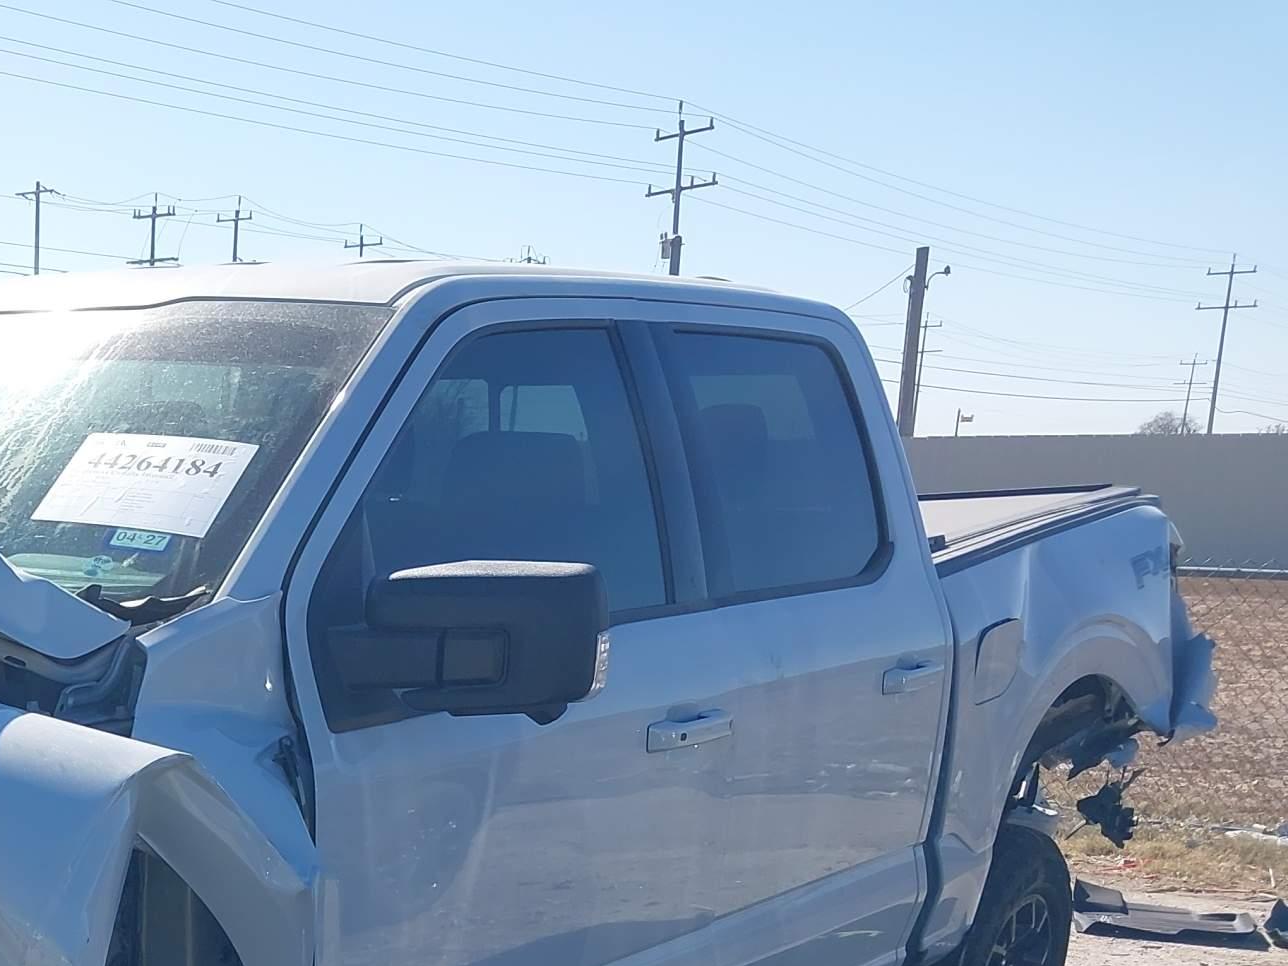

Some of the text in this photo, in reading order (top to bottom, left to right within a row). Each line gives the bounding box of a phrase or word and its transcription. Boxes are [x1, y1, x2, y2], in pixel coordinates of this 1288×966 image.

[88, 452, 223, 478] 44264184
[116, 531, 137, 543] 04
[143, 534, 167, 546] 27
